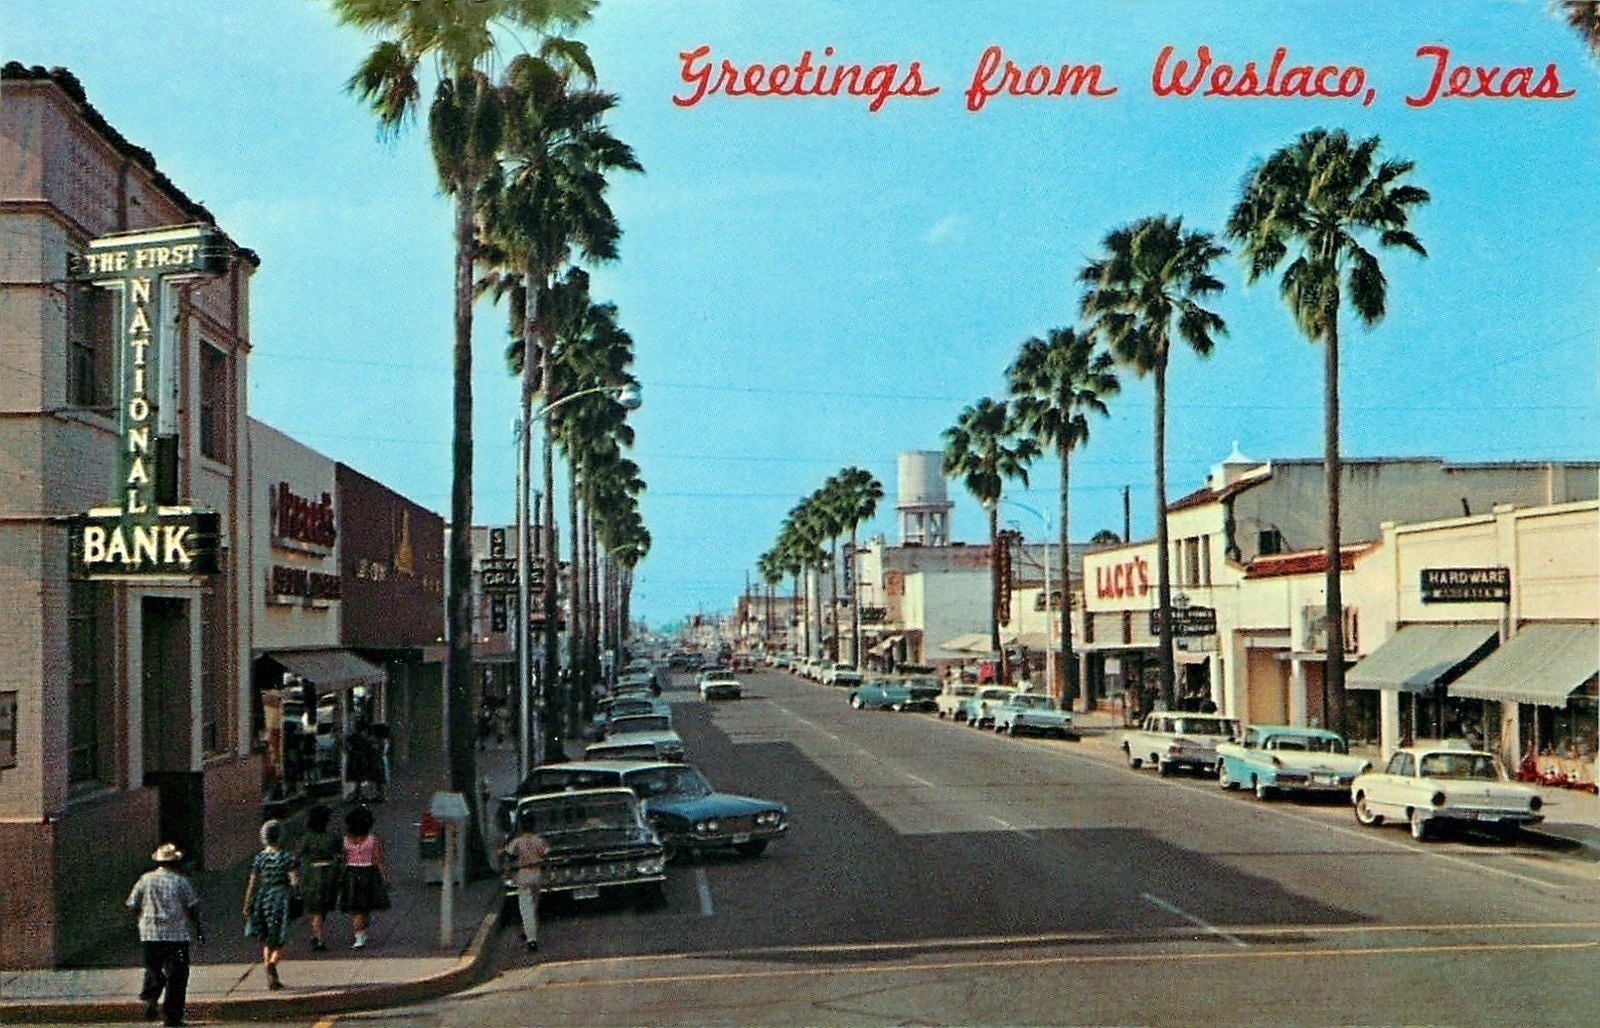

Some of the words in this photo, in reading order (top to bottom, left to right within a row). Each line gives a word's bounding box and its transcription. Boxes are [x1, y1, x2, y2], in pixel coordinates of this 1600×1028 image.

[87, 250, 129, 274] THE
[135, 243, 199, 269] FIRST
[127, 275, 153, 515] NATIONAL
[82, 523, 195, 566] BANK
[1095, 555, 1150, 600] LACK'S
[1427, 569, 1507, 585] HARDWARE
